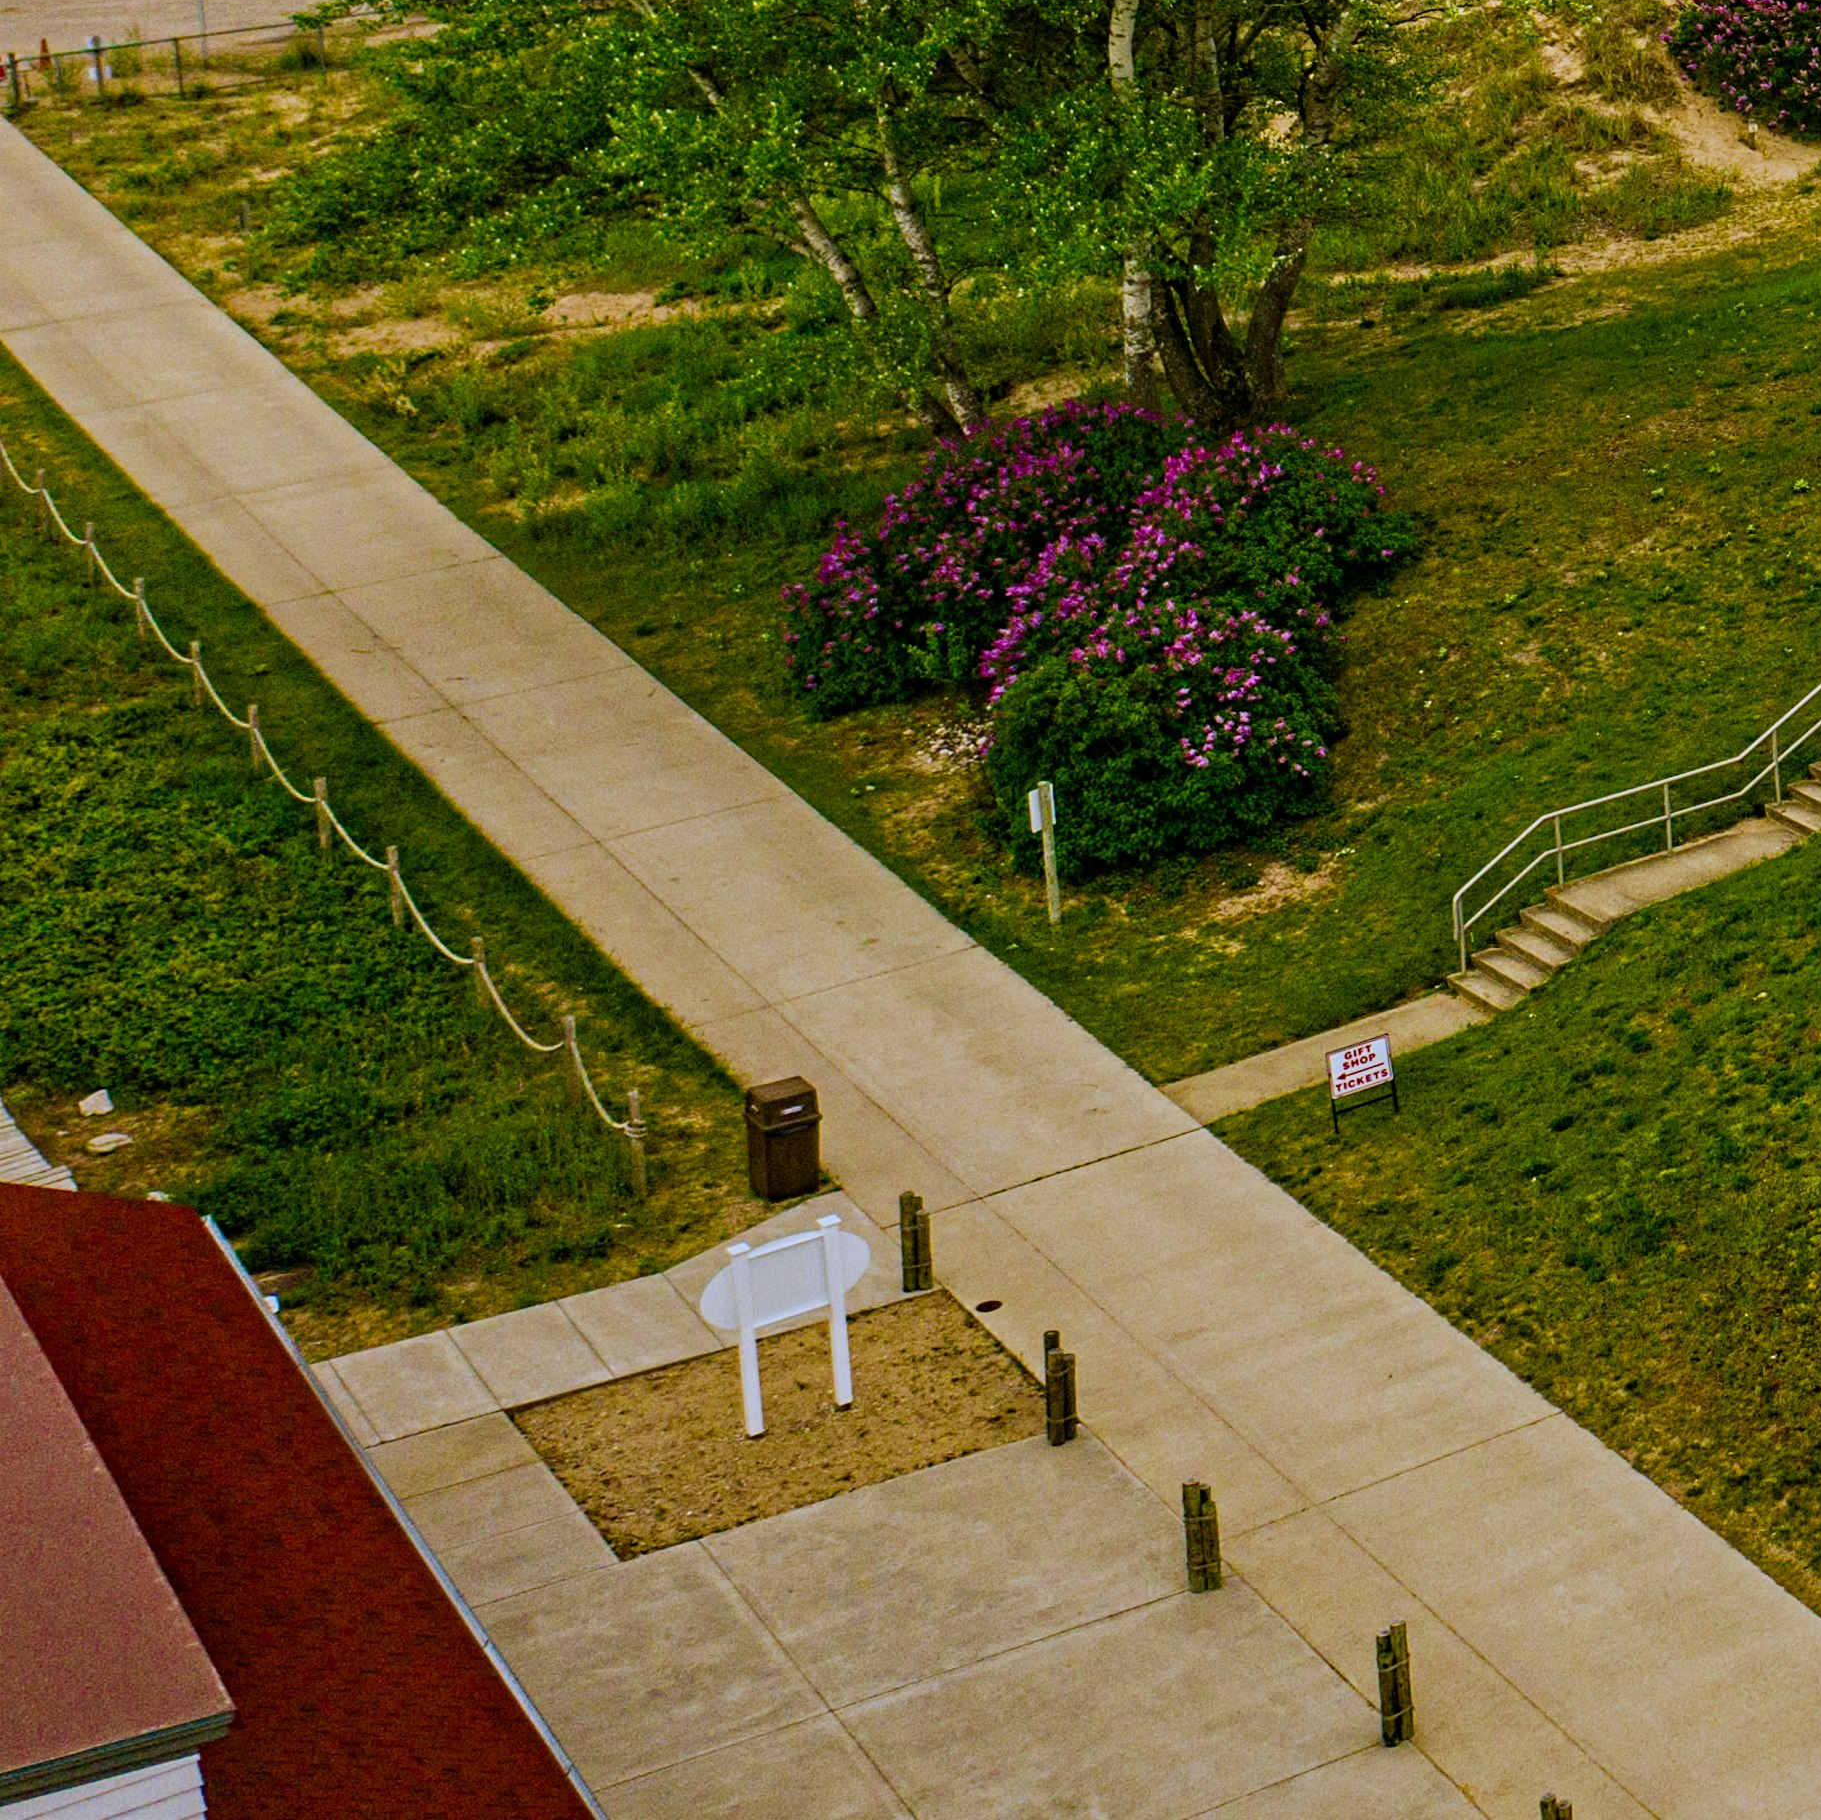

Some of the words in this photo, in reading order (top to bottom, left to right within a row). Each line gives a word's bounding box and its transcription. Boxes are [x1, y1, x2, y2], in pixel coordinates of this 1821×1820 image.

[1344, 1044, 1372, 1060] GIFT
[1342, 1053, 1376, 1070] SHOP
[1336, 1069, 1389, 1092] TICKETS
